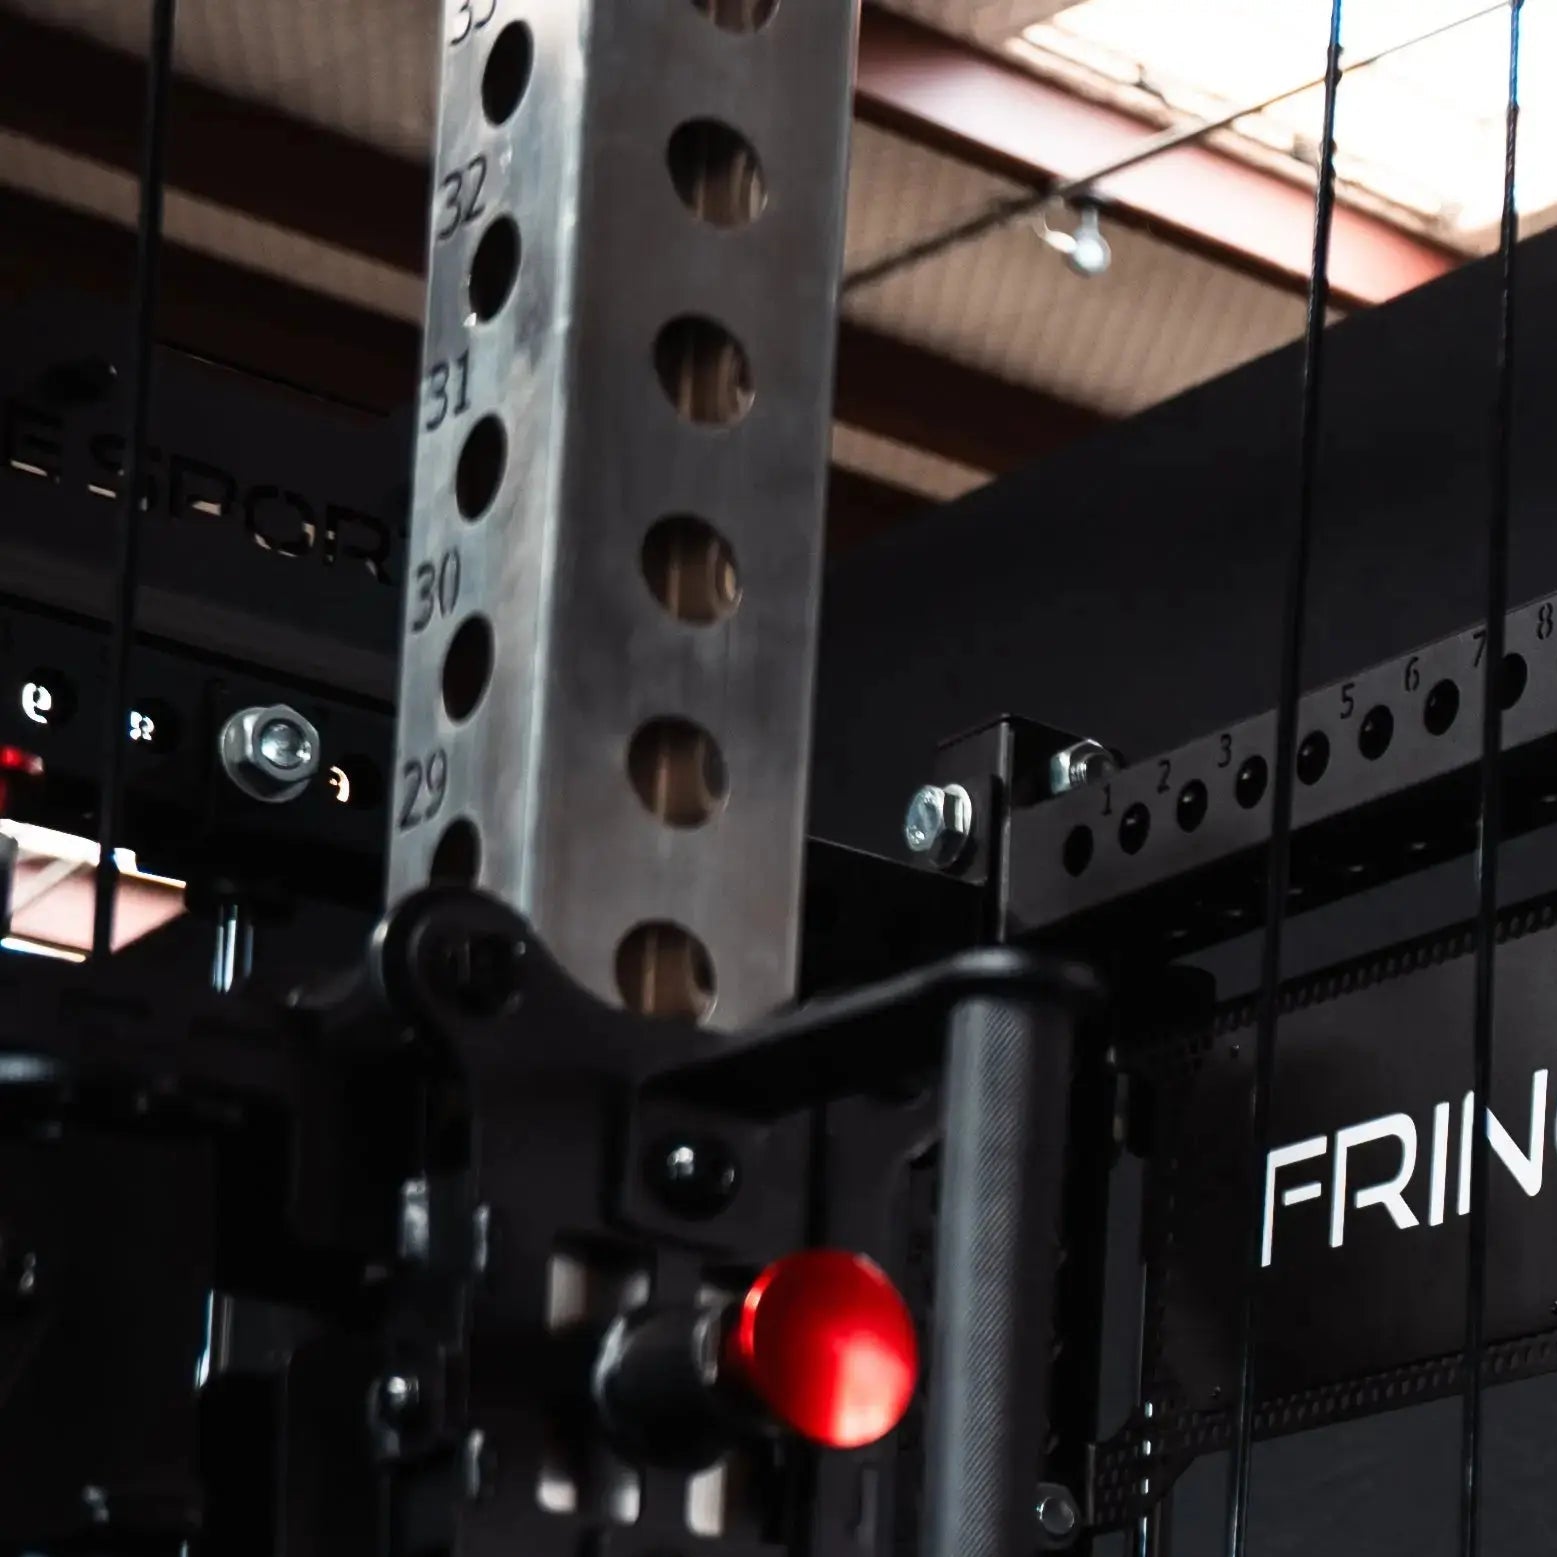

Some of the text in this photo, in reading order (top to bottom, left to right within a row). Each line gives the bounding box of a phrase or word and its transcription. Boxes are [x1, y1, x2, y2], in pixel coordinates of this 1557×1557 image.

[436, 155, 487, 241] 32
[425, 357, 470, 431] 31
[88, 433, 408, 587] SPOR
[411, 548, 460, 633] 30
[1157, 760, 1170, 792] 2
[1217, 734, 1232, 767] 3
[1340, 684, 1354, 719] 5
[1404, 658, 1420, 692] 6
[1472, 632, 1487, 668] 7
[1536, 603, 1553, 639] 8
[402, 749, 447, 826] 29
